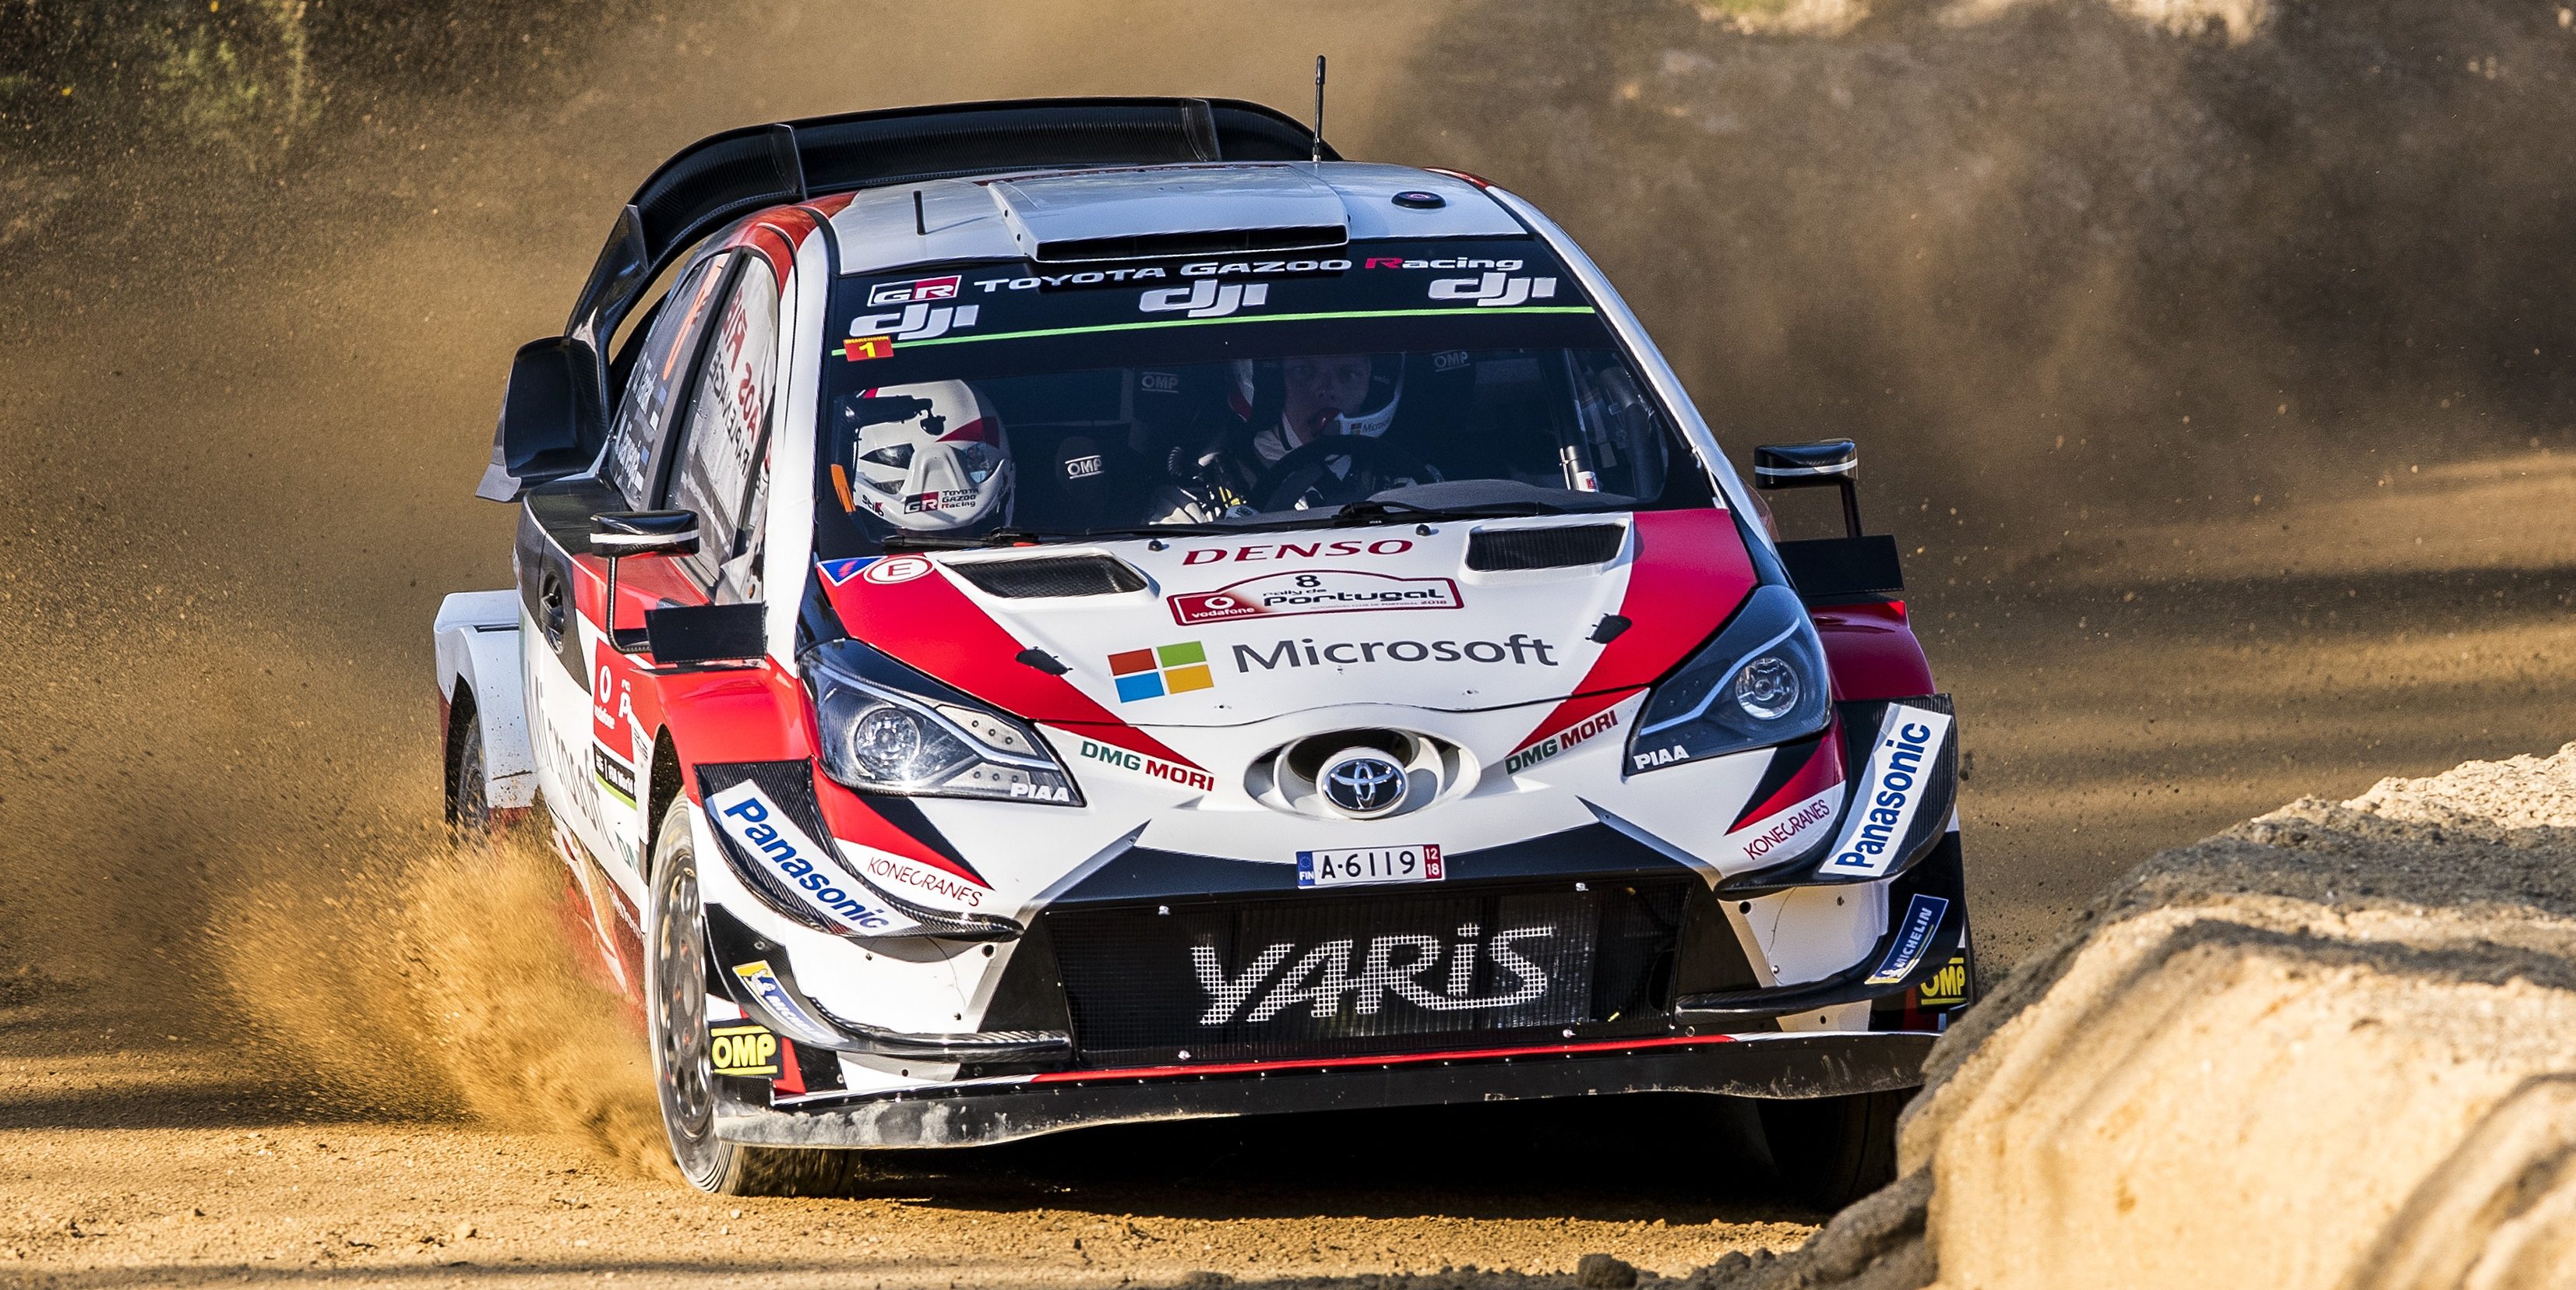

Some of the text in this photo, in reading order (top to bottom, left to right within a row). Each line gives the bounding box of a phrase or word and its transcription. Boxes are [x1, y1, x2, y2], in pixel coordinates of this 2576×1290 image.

[974, 256, 1524, 292] TOYOTA GAZOO Racing
[872, 280, 959, 305] GR
[858, 341, 876, 358] 1
[1434, 351, 1469, 368] OMP
[1142, 374, 1179, 391] OMP
[1066, 457, 1103, 477] OMP
[904, 495, 938, 514] GR
[1182, 538, 1413, 566] DENSO
[887, 562, 913, 577] E
[1295, 574, 1322, 587] 8
[1263, 589, 1445, 607] Portugal
[1192, 606, 1255, 619] vodafone
[1232, 633, 1559, 674] Microsoft
[1504, 710, 1619, 776] DMG MORI
[1080, 740, 1214, 792] DMG MORI
[1633, 745, 1690, 770] PIAA
[1010, 783, 1070, 802] PIAA
[1834, 723, 1931, 869] Panasonic
[1743, 798, 1831, 861] KONECRANES
[724, 798, 890, 930] Panasonic
[1321, 851, 1415, 879] A-6119
[1425, 848, 1439, 860] 12
[867, 856, 985, 908] KONECRANES
[1299, 871, 1314, 881] FIN
[1427, 863, 1440, 876] 18
[1895, 908, 1933, 970] MICHELIN
[710, 1033, 777, 1070] OMP
